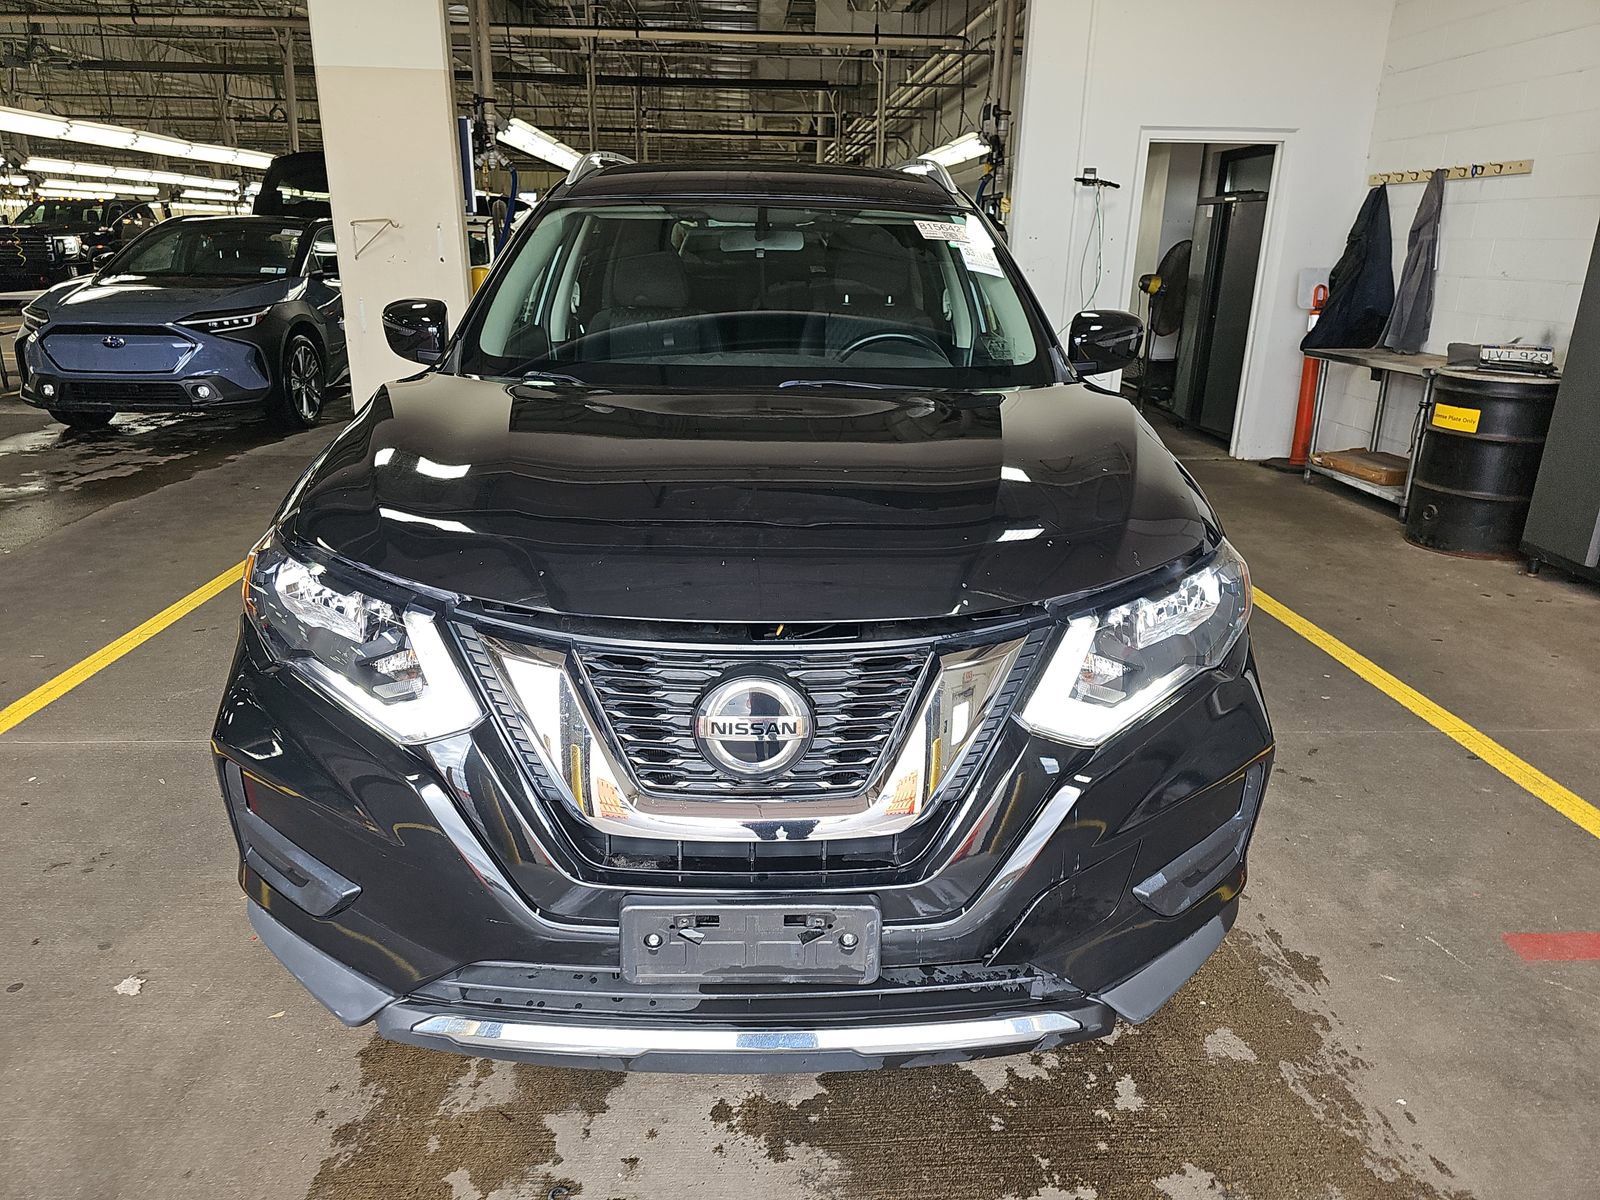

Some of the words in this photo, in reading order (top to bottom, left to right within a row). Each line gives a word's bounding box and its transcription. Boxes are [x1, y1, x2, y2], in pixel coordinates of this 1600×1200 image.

[1519, 351, 1549, 362] 929
[1447, 414, 1462, 423] Plate
[1462, 417, 1477, 425] Only
[710, 721, 798, 736] NISSAN
